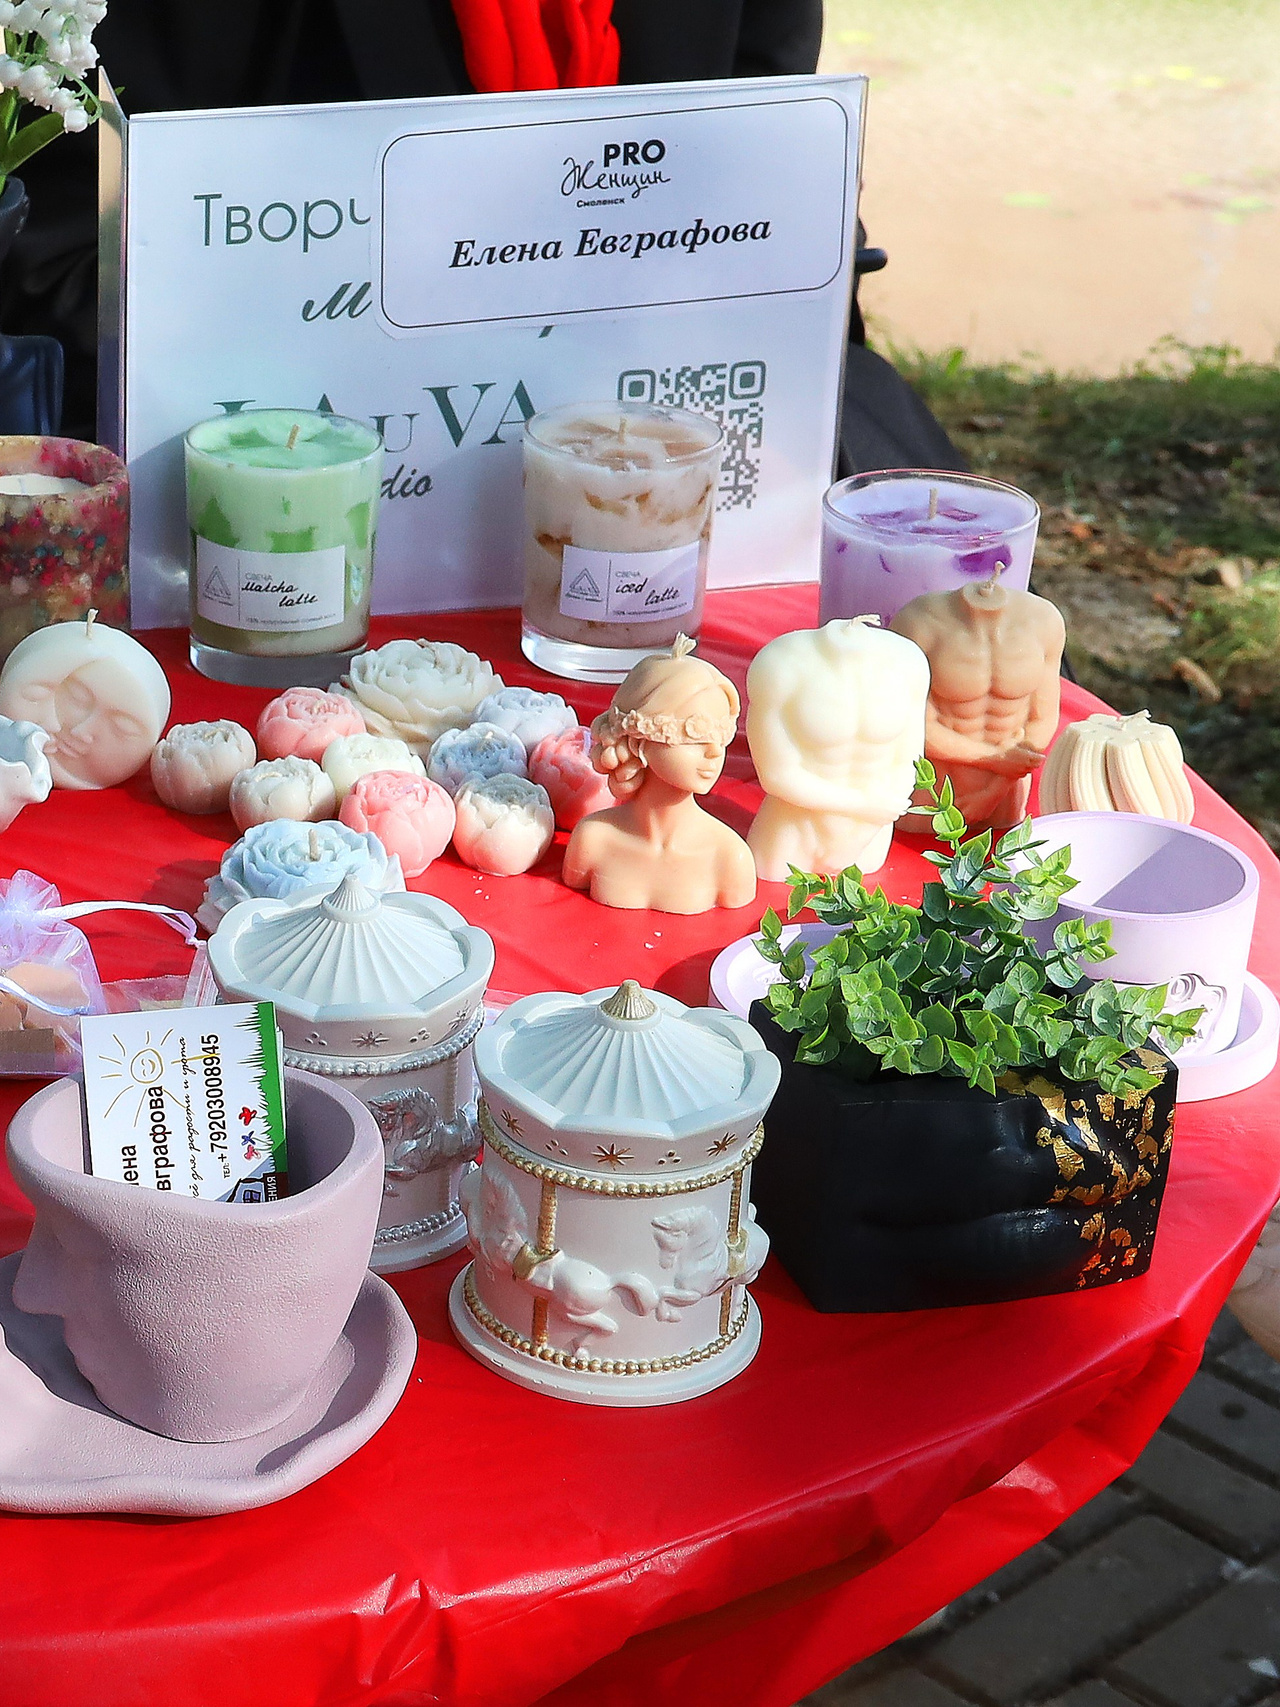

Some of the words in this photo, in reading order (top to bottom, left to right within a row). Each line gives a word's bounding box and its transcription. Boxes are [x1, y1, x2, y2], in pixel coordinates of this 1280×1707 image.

[602, 139, 666, 168] PRO
[560, 157, 671, 198] Женщин
[576, 197, 626, 208] Смоленск
[448, 239, 563, 268] Елена
[573, 218, 772, 260] Евграфова
[615, 577, 648, 594] iced
[147, 1085, 175, 1191] вграфова
